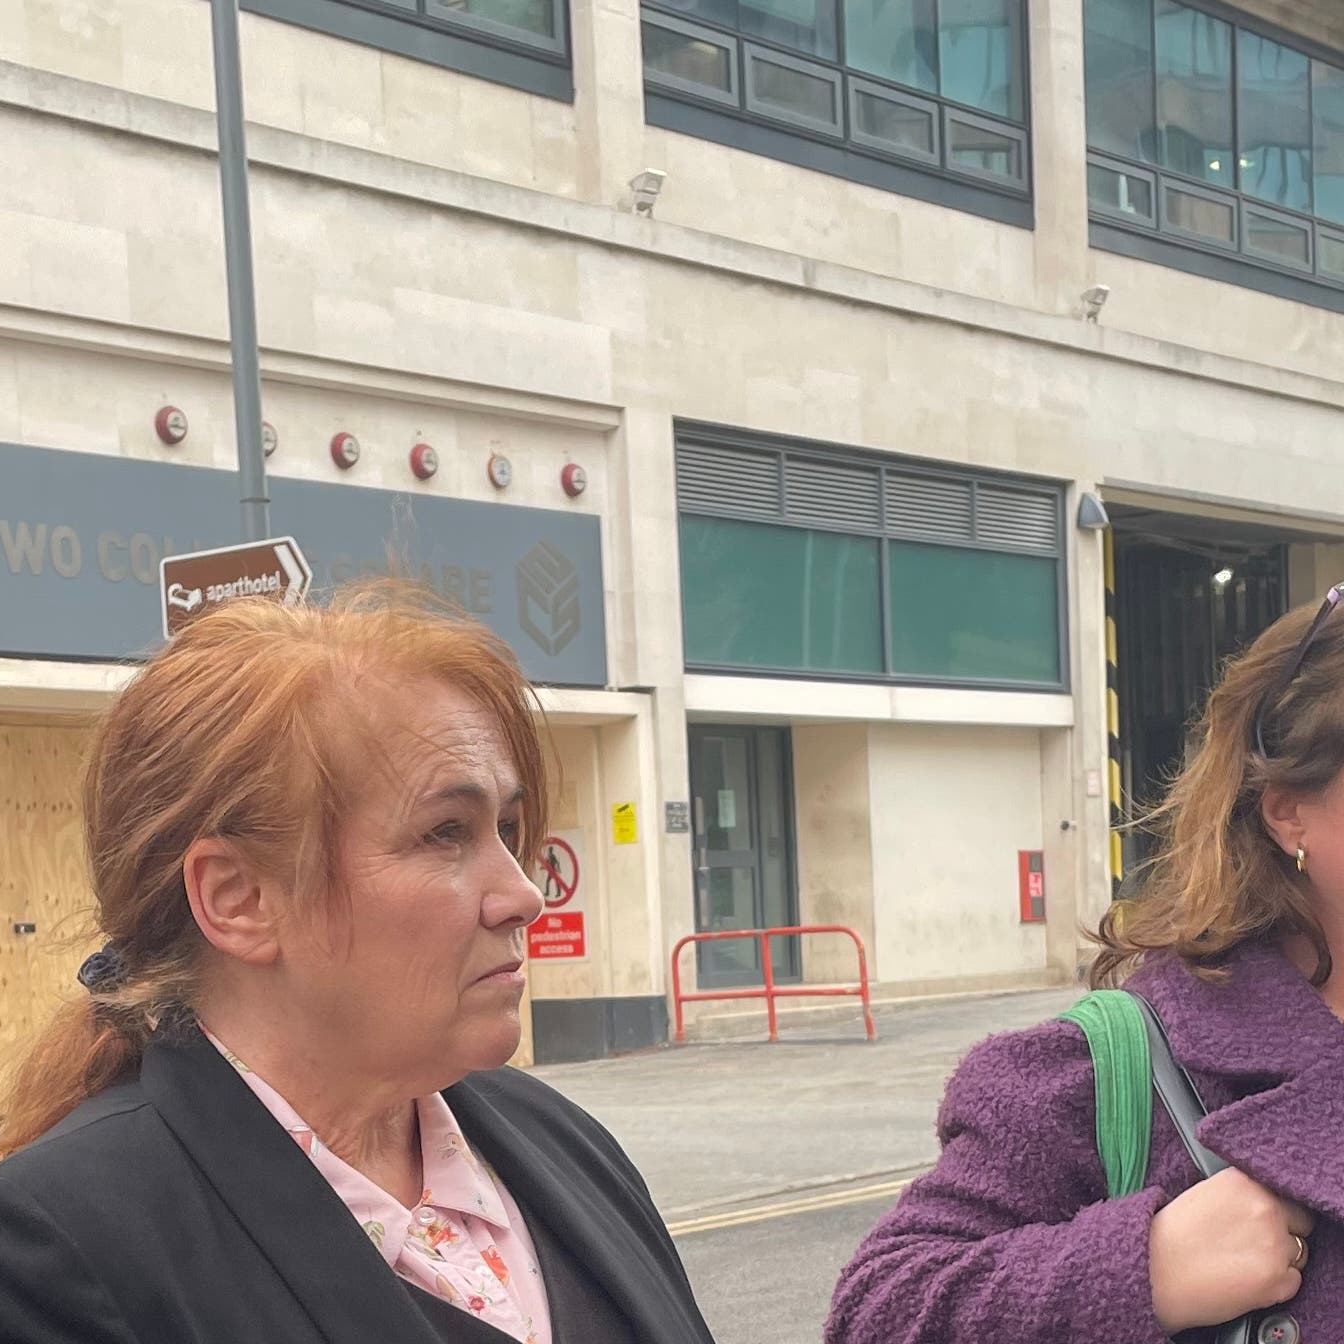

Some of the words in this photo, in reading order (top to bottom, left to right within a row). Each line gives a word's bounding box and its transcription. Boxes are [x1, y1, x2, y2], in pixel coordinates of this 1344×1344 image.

[206, 571, 281, 602] aparthotel
[547, 917, 562, 928] No
[530, 930, 582, 944] pedestrian
[539, 945, 574, 954] access
